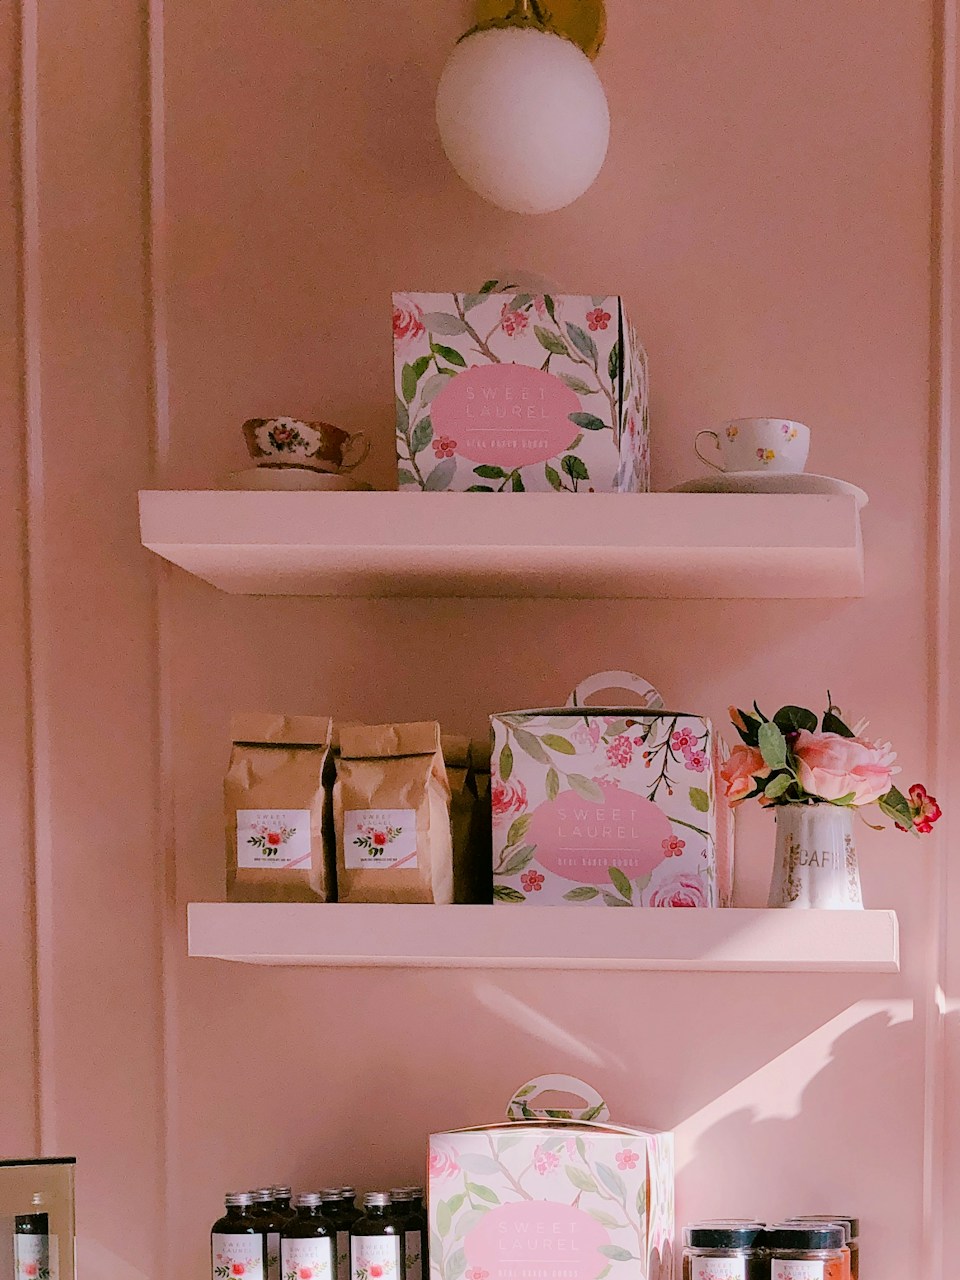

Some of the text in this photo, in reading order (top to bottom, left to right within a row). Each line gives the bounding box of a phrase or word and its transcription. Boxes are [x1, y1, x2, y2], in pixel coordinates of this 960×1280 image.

[465, 386, 548, 400] SWEET
[465, 404, 549, 419] LAUREL
[557, 808, 638, 821] SWEET
[558, 826, 639, 839] LAUREL
[498, 1222, 577, 1233] SWEET
[498, 1239, 579, 1251] LAUREL
